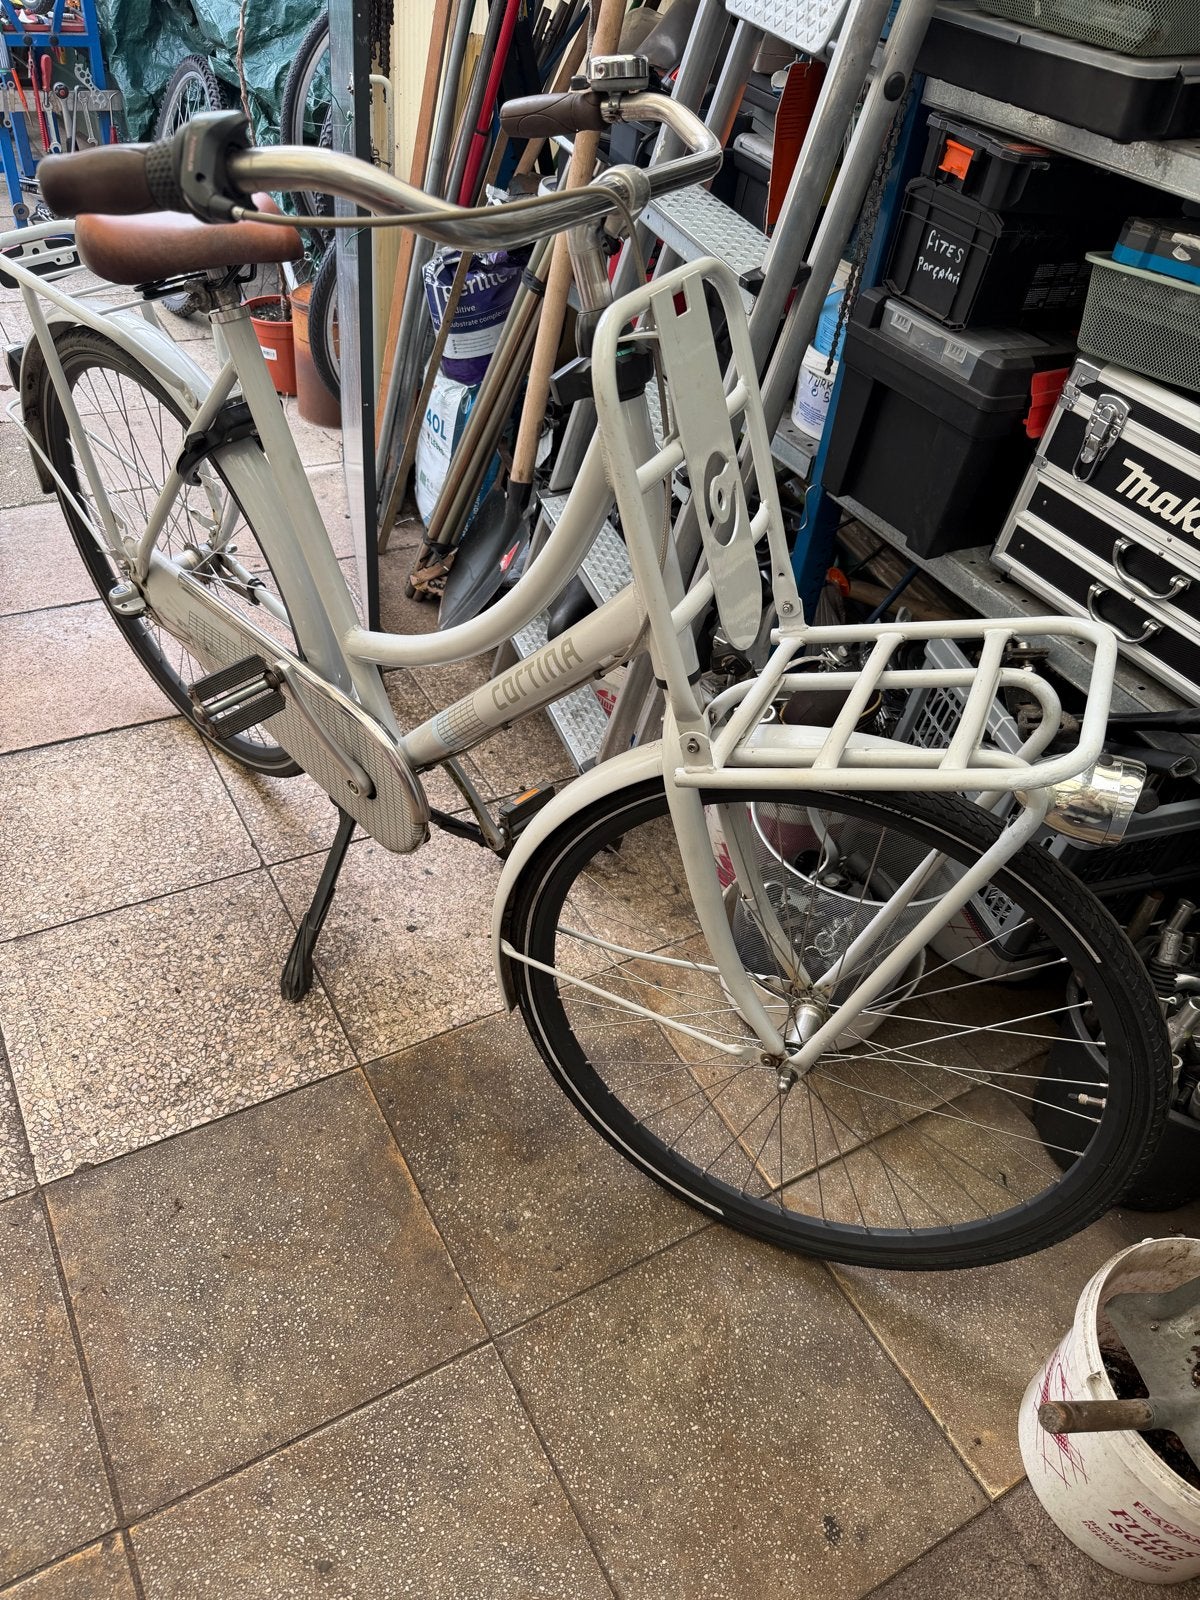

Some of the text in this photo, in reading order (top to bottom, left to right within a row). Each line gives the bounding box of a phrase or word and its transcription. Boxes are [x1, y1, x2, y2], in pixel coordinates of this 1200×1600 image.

[426, 408, 447, 441] 40L
[491, 637, 583, 710] CORTINA
[1108, 1509, 1200, 1558] Frites
[1108, 1522, 1185, 1561] saus
